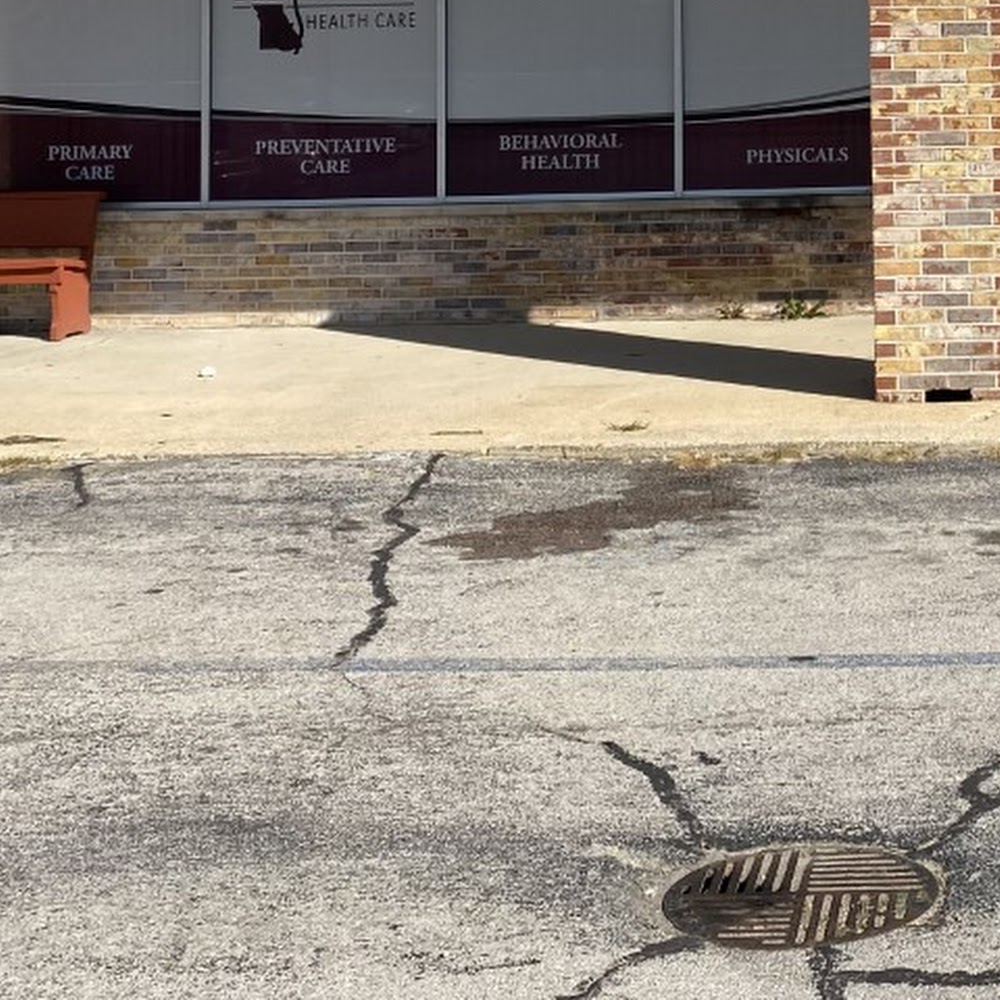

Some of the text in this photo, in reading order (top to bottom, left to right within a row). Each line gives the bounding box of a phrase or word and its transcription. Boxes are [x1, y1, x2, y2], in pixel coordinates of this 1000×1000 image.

[306, 12, 416, 30] HEALTH CARE
[255, 137, 397, 156] PREVENTATIVE
[499, 132, 623, 151] BEHAVIORAL
[46, 144, 134, 162] PRIMARY
[521, 153, 601, 170] HEALTH
[745, 147, 850, 165] PHYSICALS
[65, 165, 115, 181] CARE
[300, 159, 351, 175] CARE
